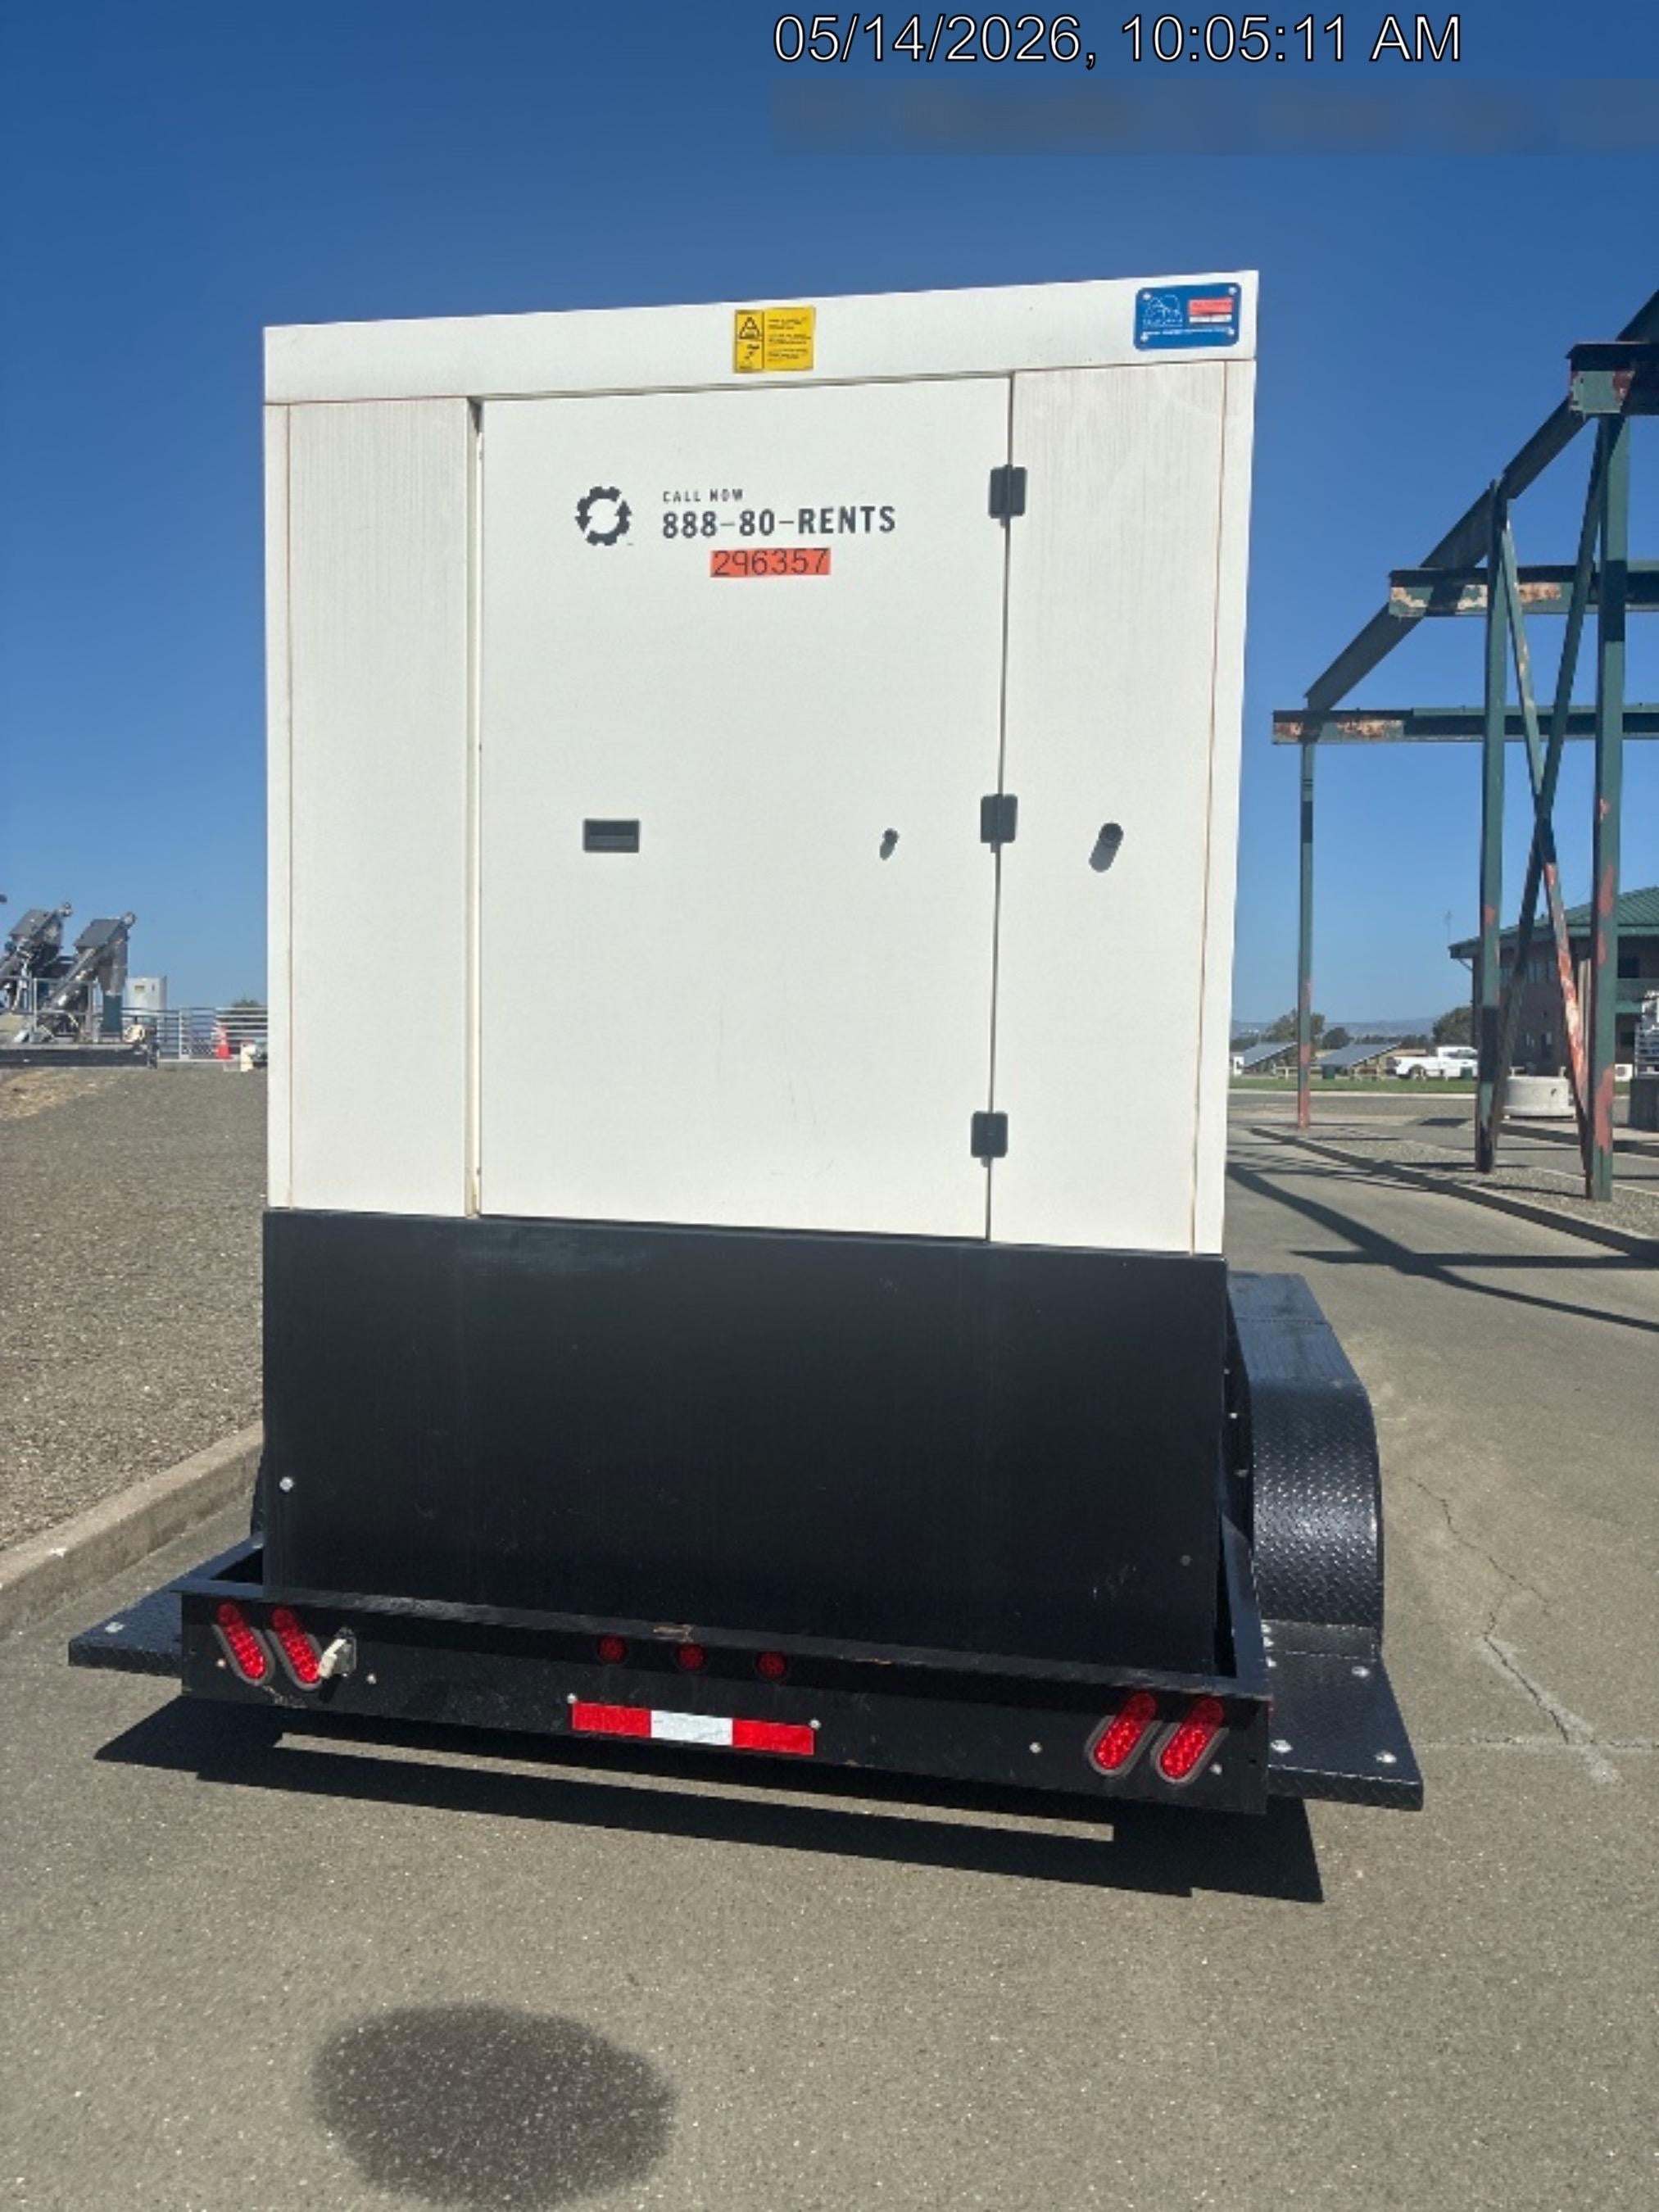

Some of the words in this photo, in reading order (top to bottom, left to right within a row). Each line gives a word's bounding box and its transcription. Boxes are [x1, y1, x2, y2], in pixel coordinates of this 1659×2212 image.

[662, 491, 701, 502] CALL
[709, 488, 744, 501] NOW
[662, 505, 896, 539] 888-80-RENTS
[713, 547, 830, 577] 296357
